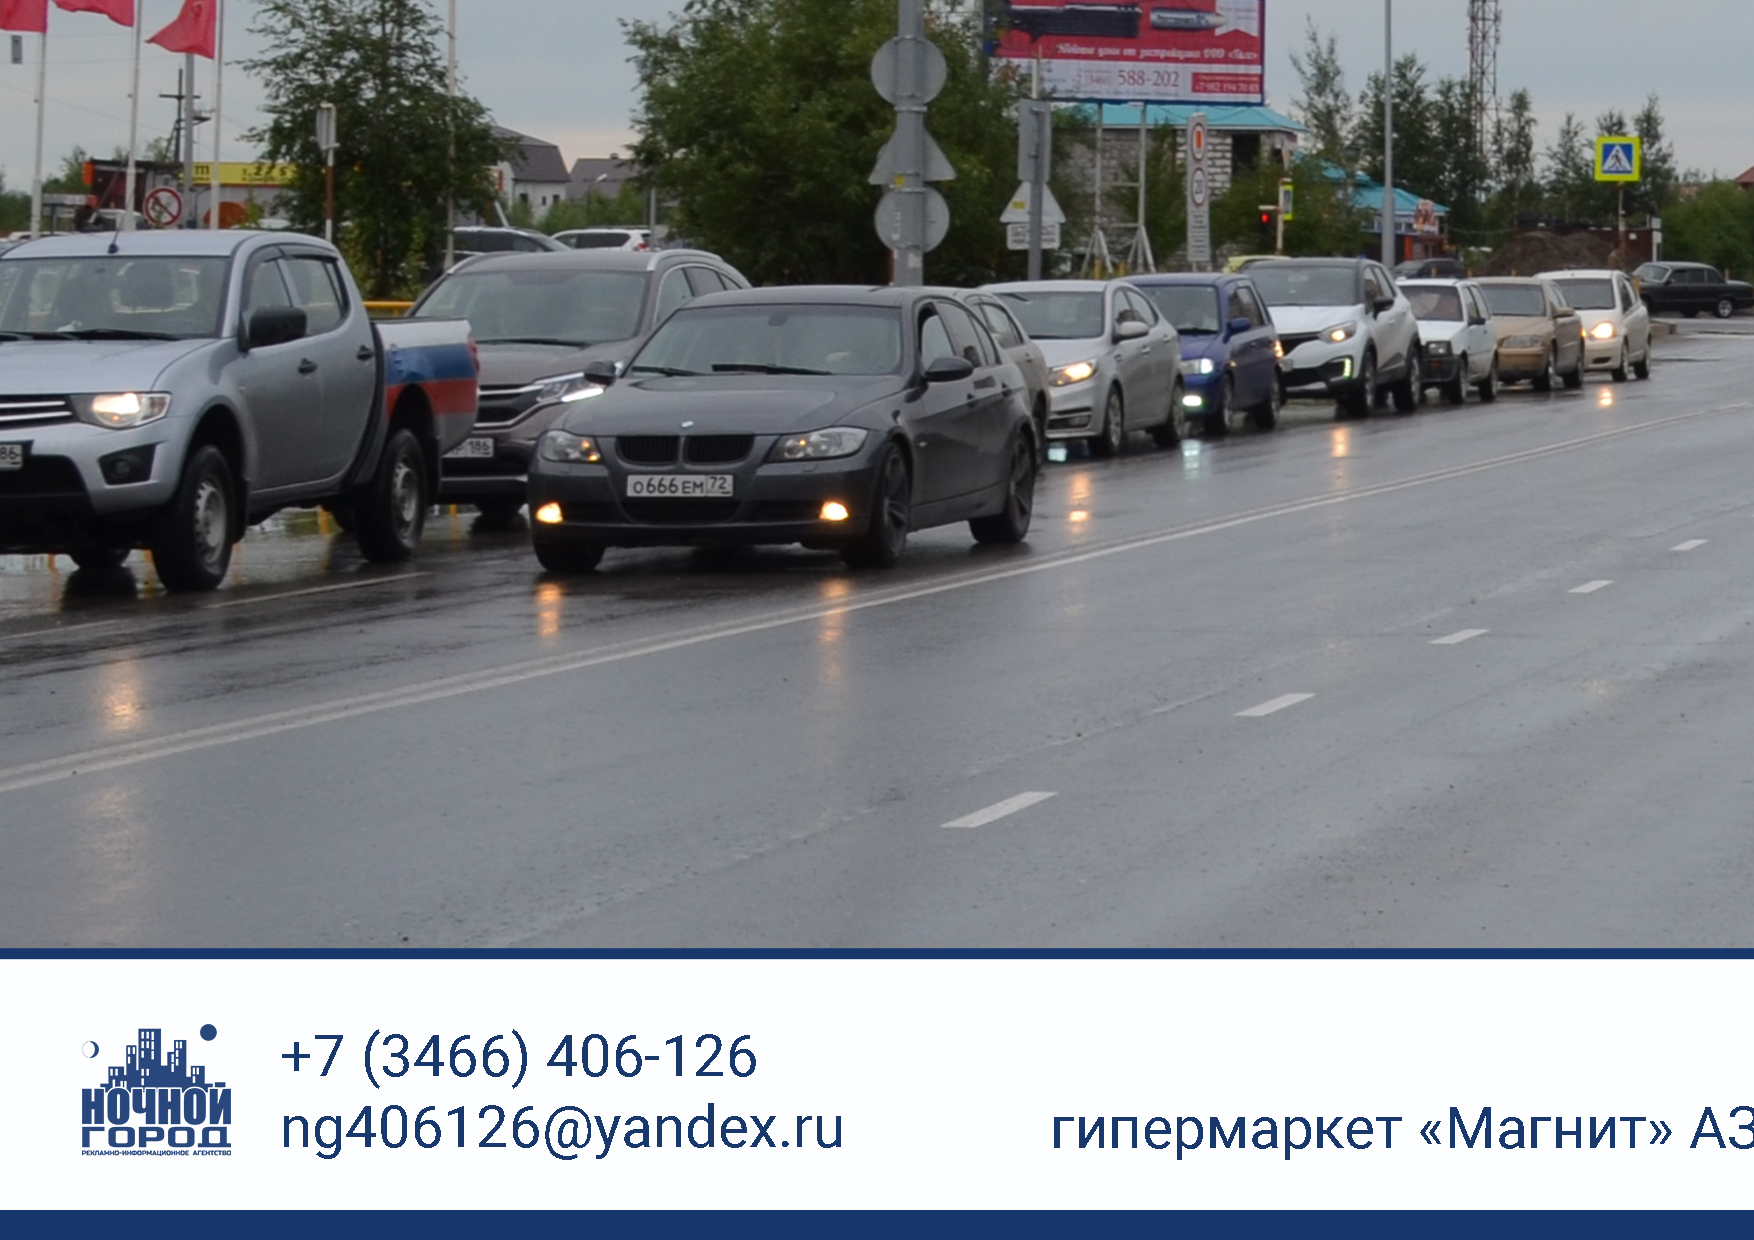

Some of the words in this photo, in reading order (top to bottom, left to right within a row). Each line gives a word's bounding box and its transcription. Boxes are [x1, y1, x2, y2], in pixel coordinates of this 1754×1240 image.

[1118, 69, 1179, 87] 588-202
[468, 440, 490, 451] 186
[633, 476, 704, 494] О666ЕМ
[710, 476, 727, 490] 72
